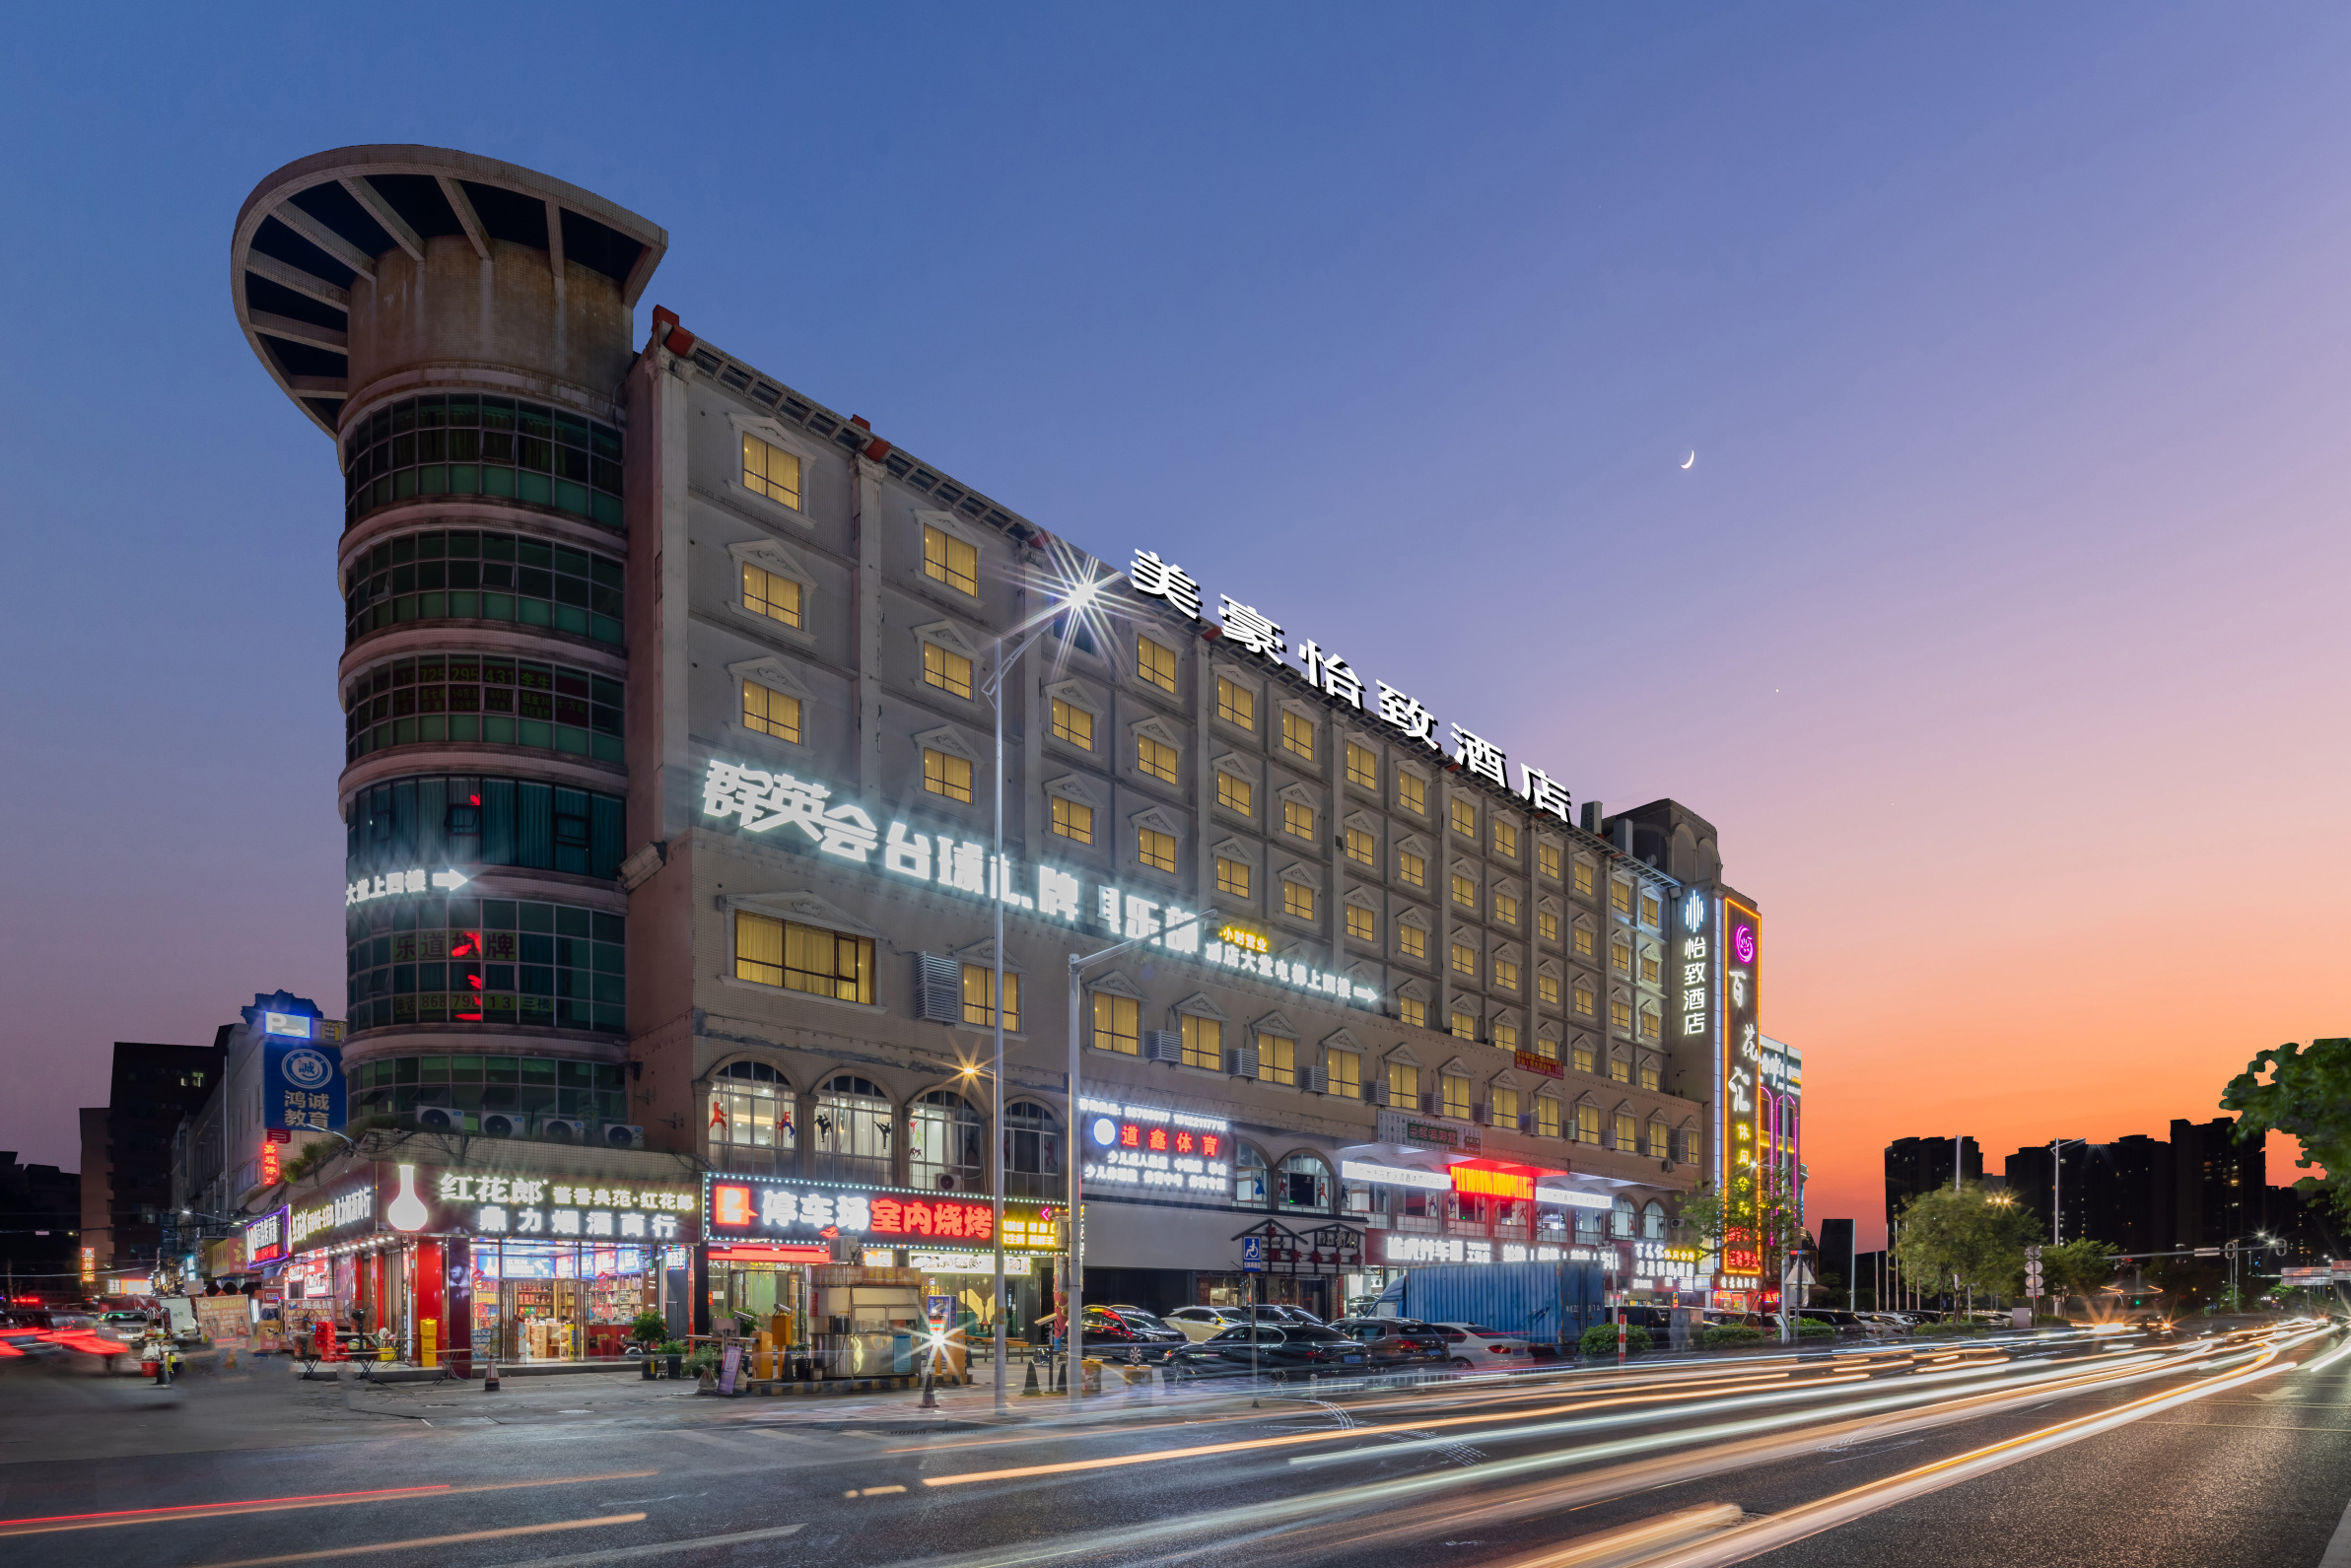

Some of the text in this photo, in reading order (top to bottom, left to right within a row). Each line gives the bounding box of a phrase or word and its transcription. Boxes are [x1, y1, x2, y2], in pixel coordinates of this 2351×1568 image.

[1130, 548, 1570, 824] 美豪怡致酒店
[395, 931, 516, 961] 乐道棋牌
[1218, 925, 1268, 953] 小时营业
[1683, 934, 1706, 1036] 怡致酒店
[265, 1012, 287, 1034] P
[1726, 969, 1760, 1114] 百花汇
[284, 1089, 330, 1111] 鸿诚
[284, 1110, 330, 1128] 教育
[1121, 1125, 1219, 1157] 道鑫体育
[440, 1173, 543, 1205] 红花郎
[478, 1205, 677, 1238] 鼎力烟酒商行
[761, 1189, 994, 1240] 停车场 室内烧烤
